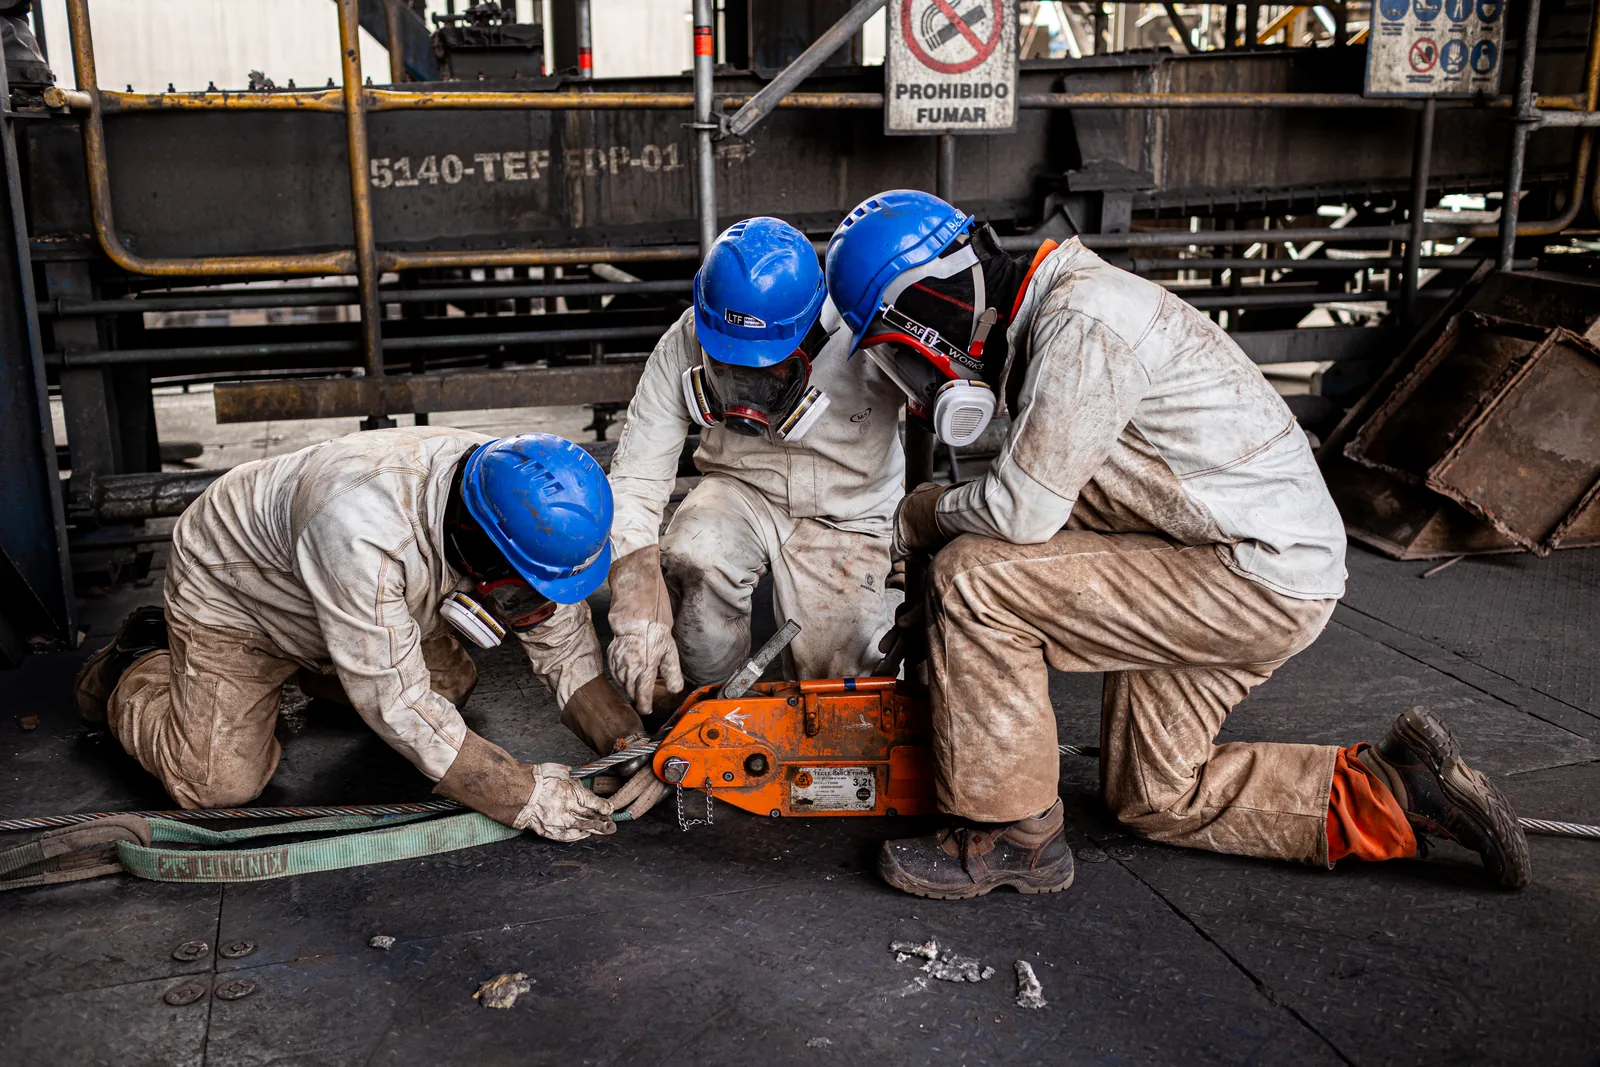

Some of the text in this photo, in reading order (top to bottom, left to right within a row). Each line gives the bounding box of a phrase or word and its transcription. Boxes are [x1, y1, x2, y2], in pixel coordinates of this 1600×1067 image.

[895, 83, 1009, 99] PROHIBIDO
[917, 107, 986, 123] FUMAR
[728, 313, 743, 324] LTF
[195, 853, 282, 877] KINGLIFT
